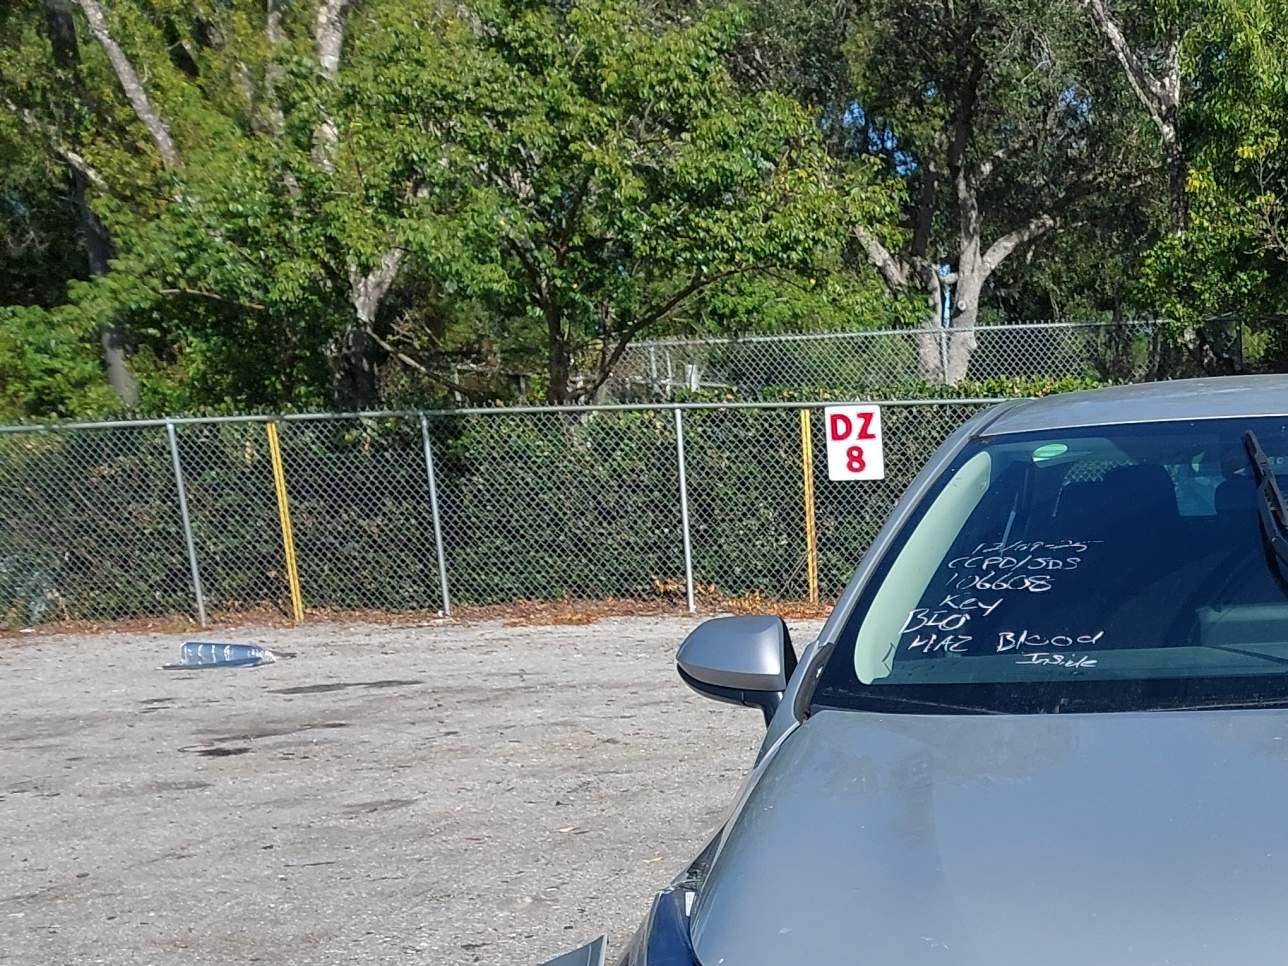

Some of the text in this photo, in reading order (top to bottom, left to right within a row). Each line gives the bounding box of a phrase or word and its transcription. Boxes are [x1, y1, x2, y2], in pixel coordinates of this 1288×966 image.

[830, 412, 876, 441] DZ
[846, 445, 866, 473] 8
[945, 570, 1055, 592] 106608
[996, 630, 1104, 652] Blood
